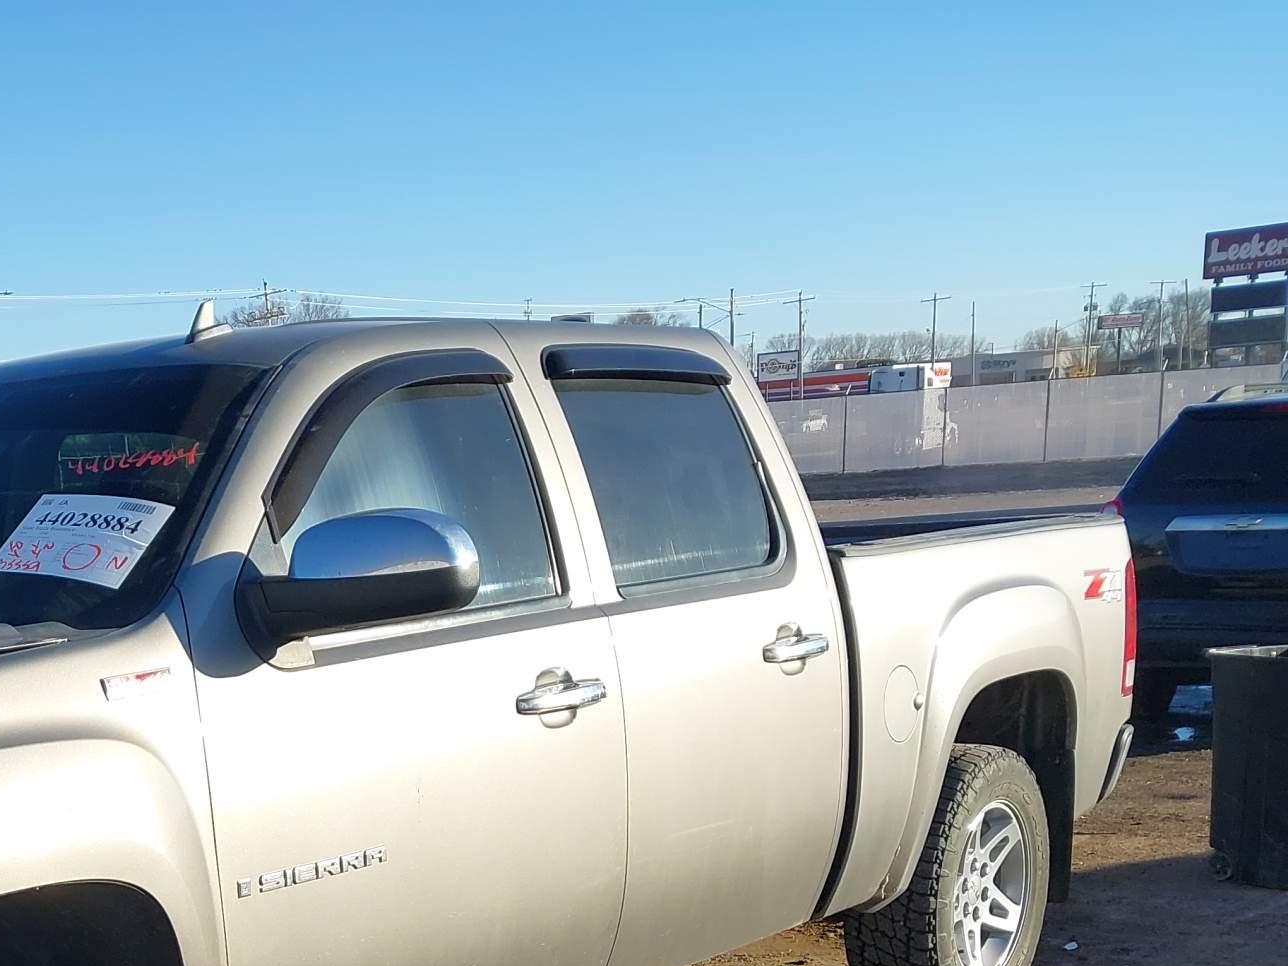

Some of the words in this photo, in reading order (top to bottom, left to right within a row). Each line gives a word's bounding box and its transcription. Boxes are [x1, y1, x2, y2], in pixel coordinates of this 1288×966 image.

[1211, 261, 1254, 274] FAMILY
[35, 511, 144, 535] 44028884
[258, 843, 388, 894] SIERRA
